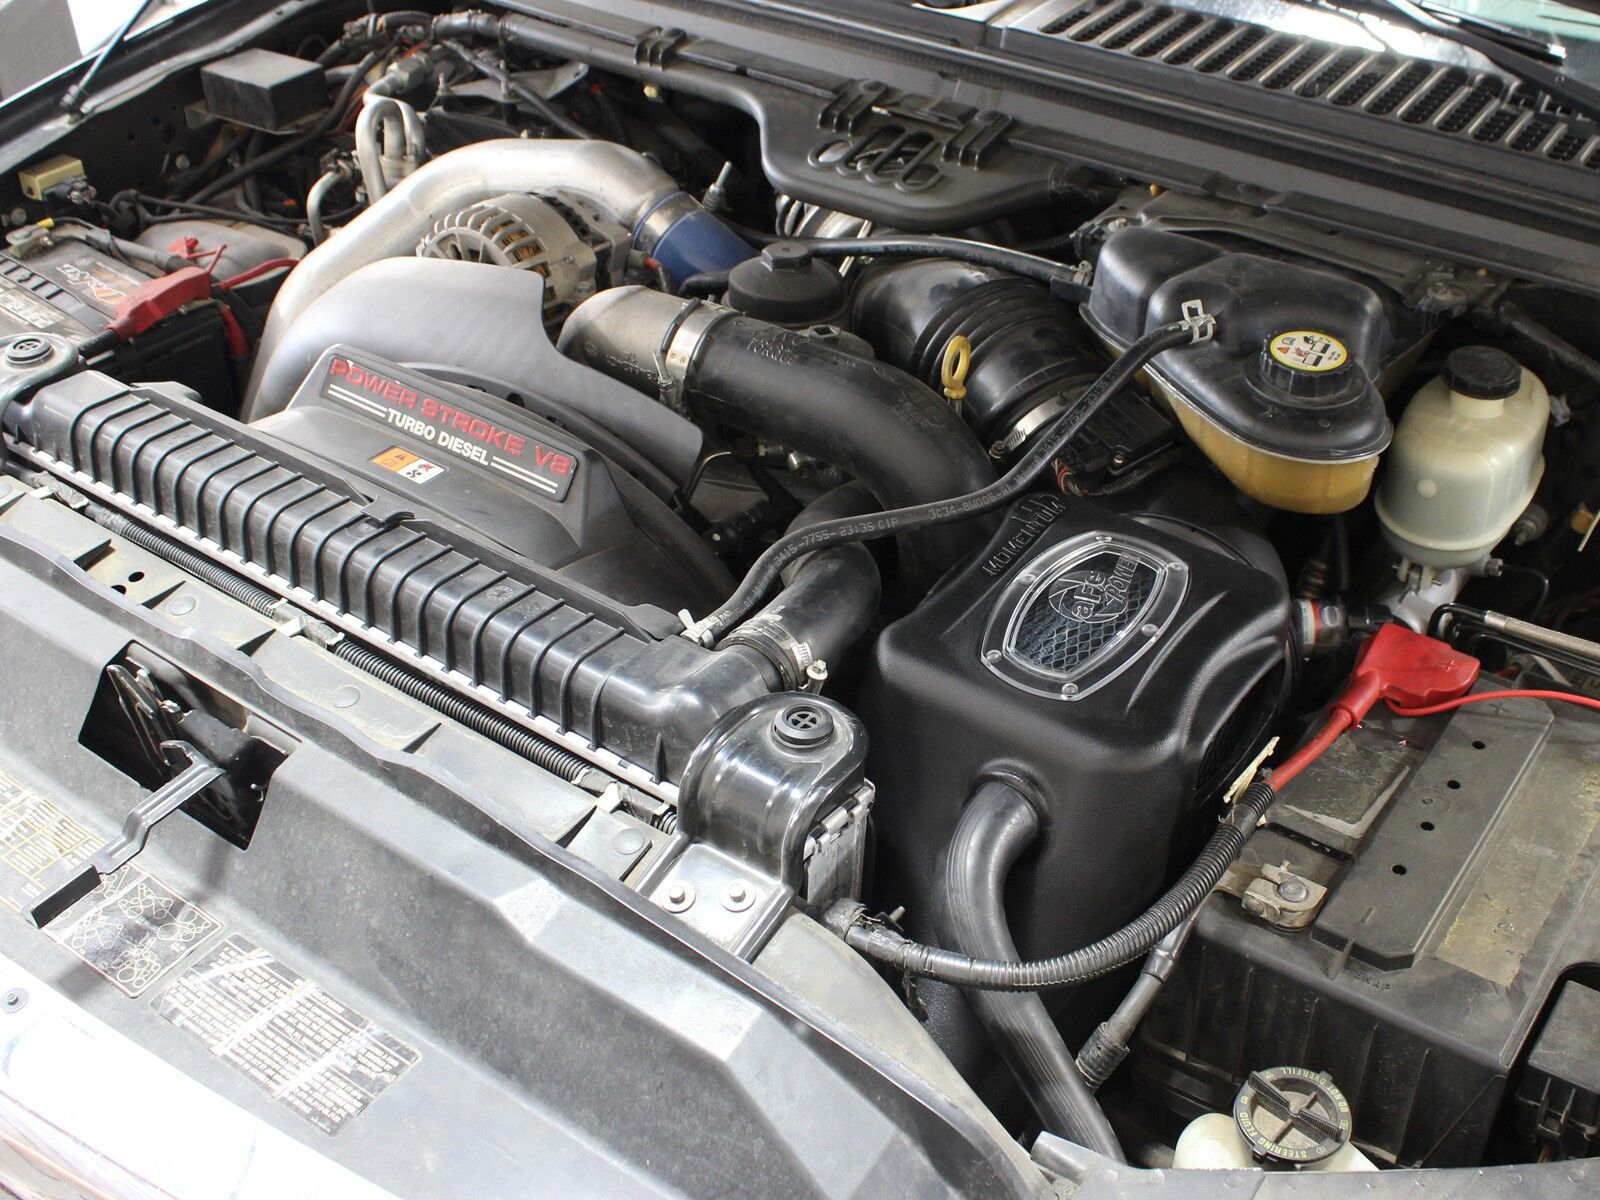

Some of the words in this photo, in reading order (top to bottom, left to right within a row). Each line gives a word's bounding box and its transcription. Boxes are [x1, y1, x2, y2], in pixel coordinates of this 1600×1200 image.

[330, 358, 418, 408] POWER
[421, 398, 526, 457] STROKE
[535, 445, 574, 478] V8
[386, 407, 435, 441] TURBO
[438, 432, 489, 466] DIESEL
[1071, 570, 1108, 620] aFe
[1281, 1067, 1326, 1086] OVERFILL
[1326, 1084, 1343, 1101] NOT
[1240, 1112, 1258, 1136] FLUID
[1258, 1136, 1308, 1159] STEERING
